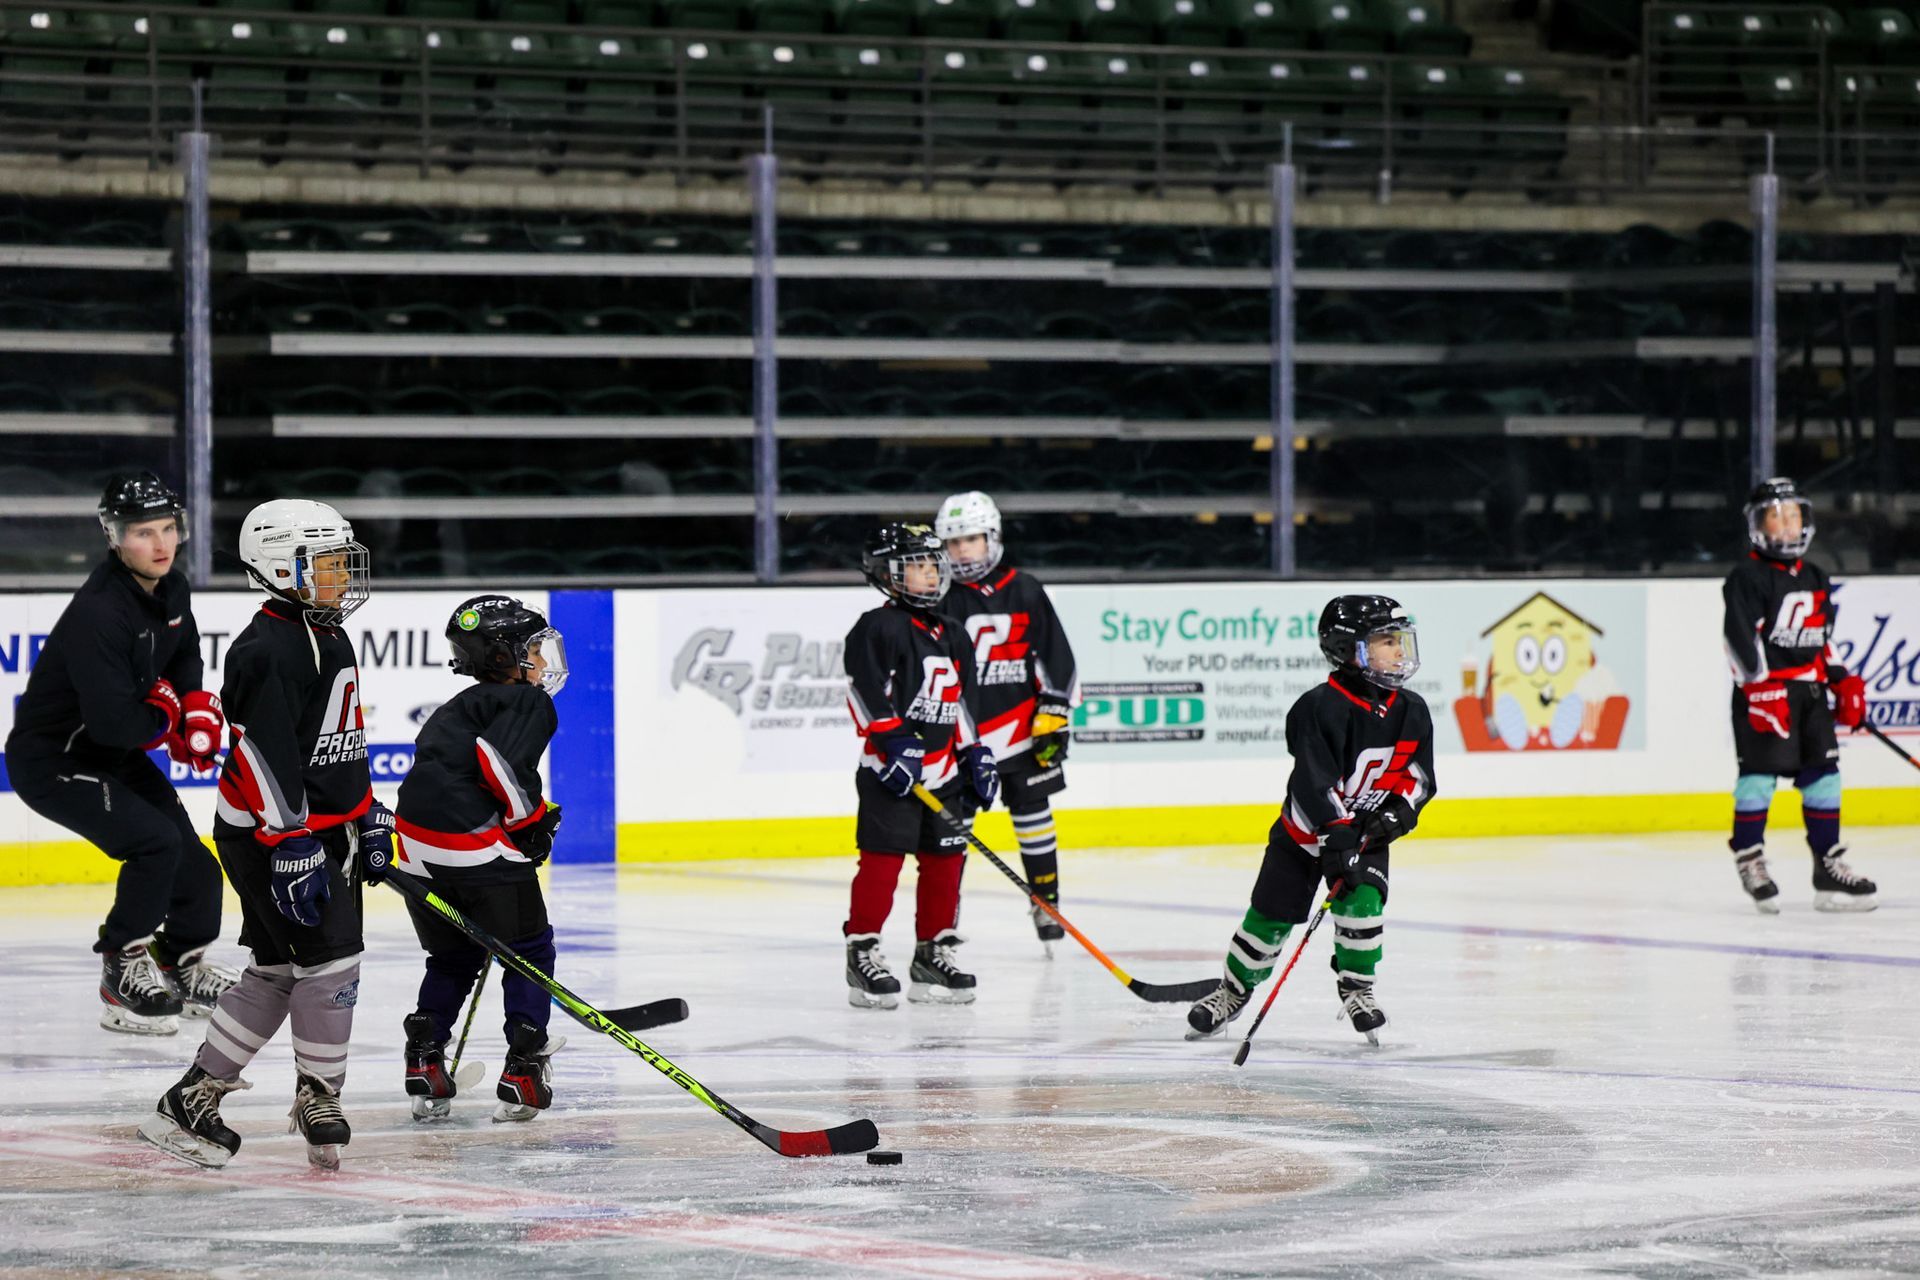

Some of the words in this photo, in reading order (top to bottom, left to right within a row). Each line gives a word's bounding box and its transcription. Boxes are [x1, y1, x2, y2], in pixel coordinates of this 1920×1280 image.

[472, 600, 511, 611] CCM
[1100, 609, 1170, 648] Stay
[1176, 607, 1279, 647] Comfy
[1286, 610, 1317, 640] at
[361, 629, 443, 667] MIL
[1143, 653, 1183, 673] Your
[1187, 654, 1227, 673] PUD
[1230, 651, 1280, 671] offers
[1073, 698, 1204, 728] PUD
[585, 1011, 696, 1090] NEXUS
